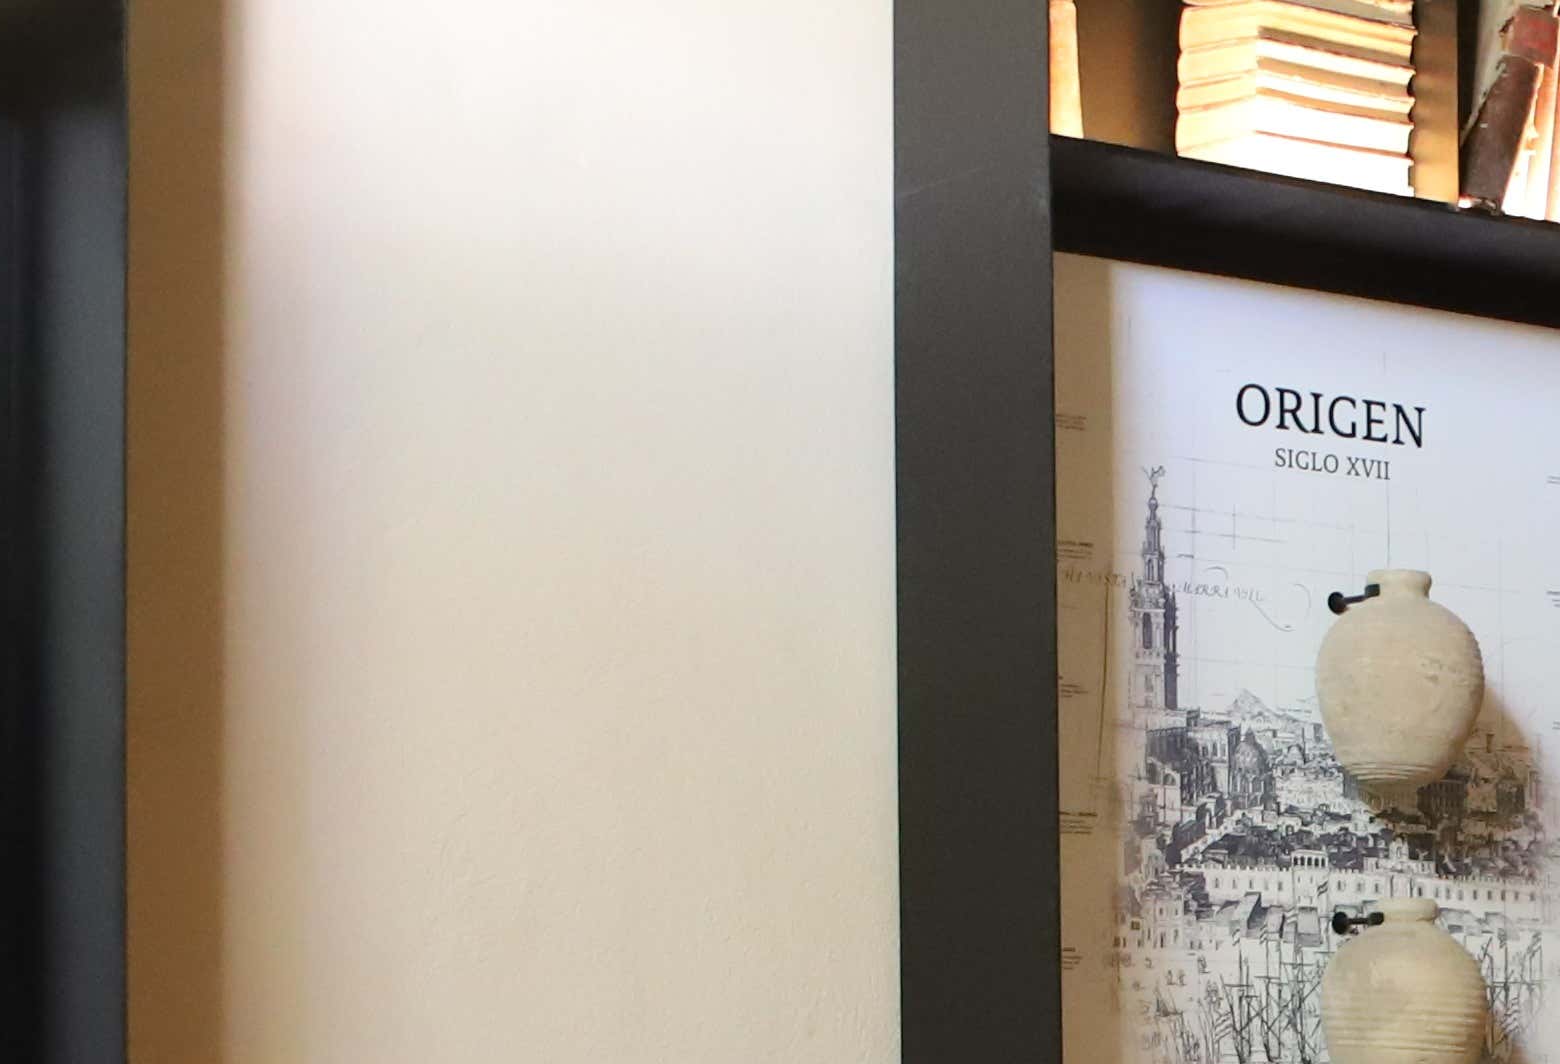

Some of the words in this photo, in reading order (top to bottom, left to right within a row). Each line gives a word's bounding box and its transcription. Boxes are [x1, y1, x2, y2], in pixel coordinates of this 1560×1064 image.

[1236, 384, 1426, 448] ORIGEN
[1274, 448, 1339, 474] SIGLO
[1345, 456, 1390, 480] XVII
